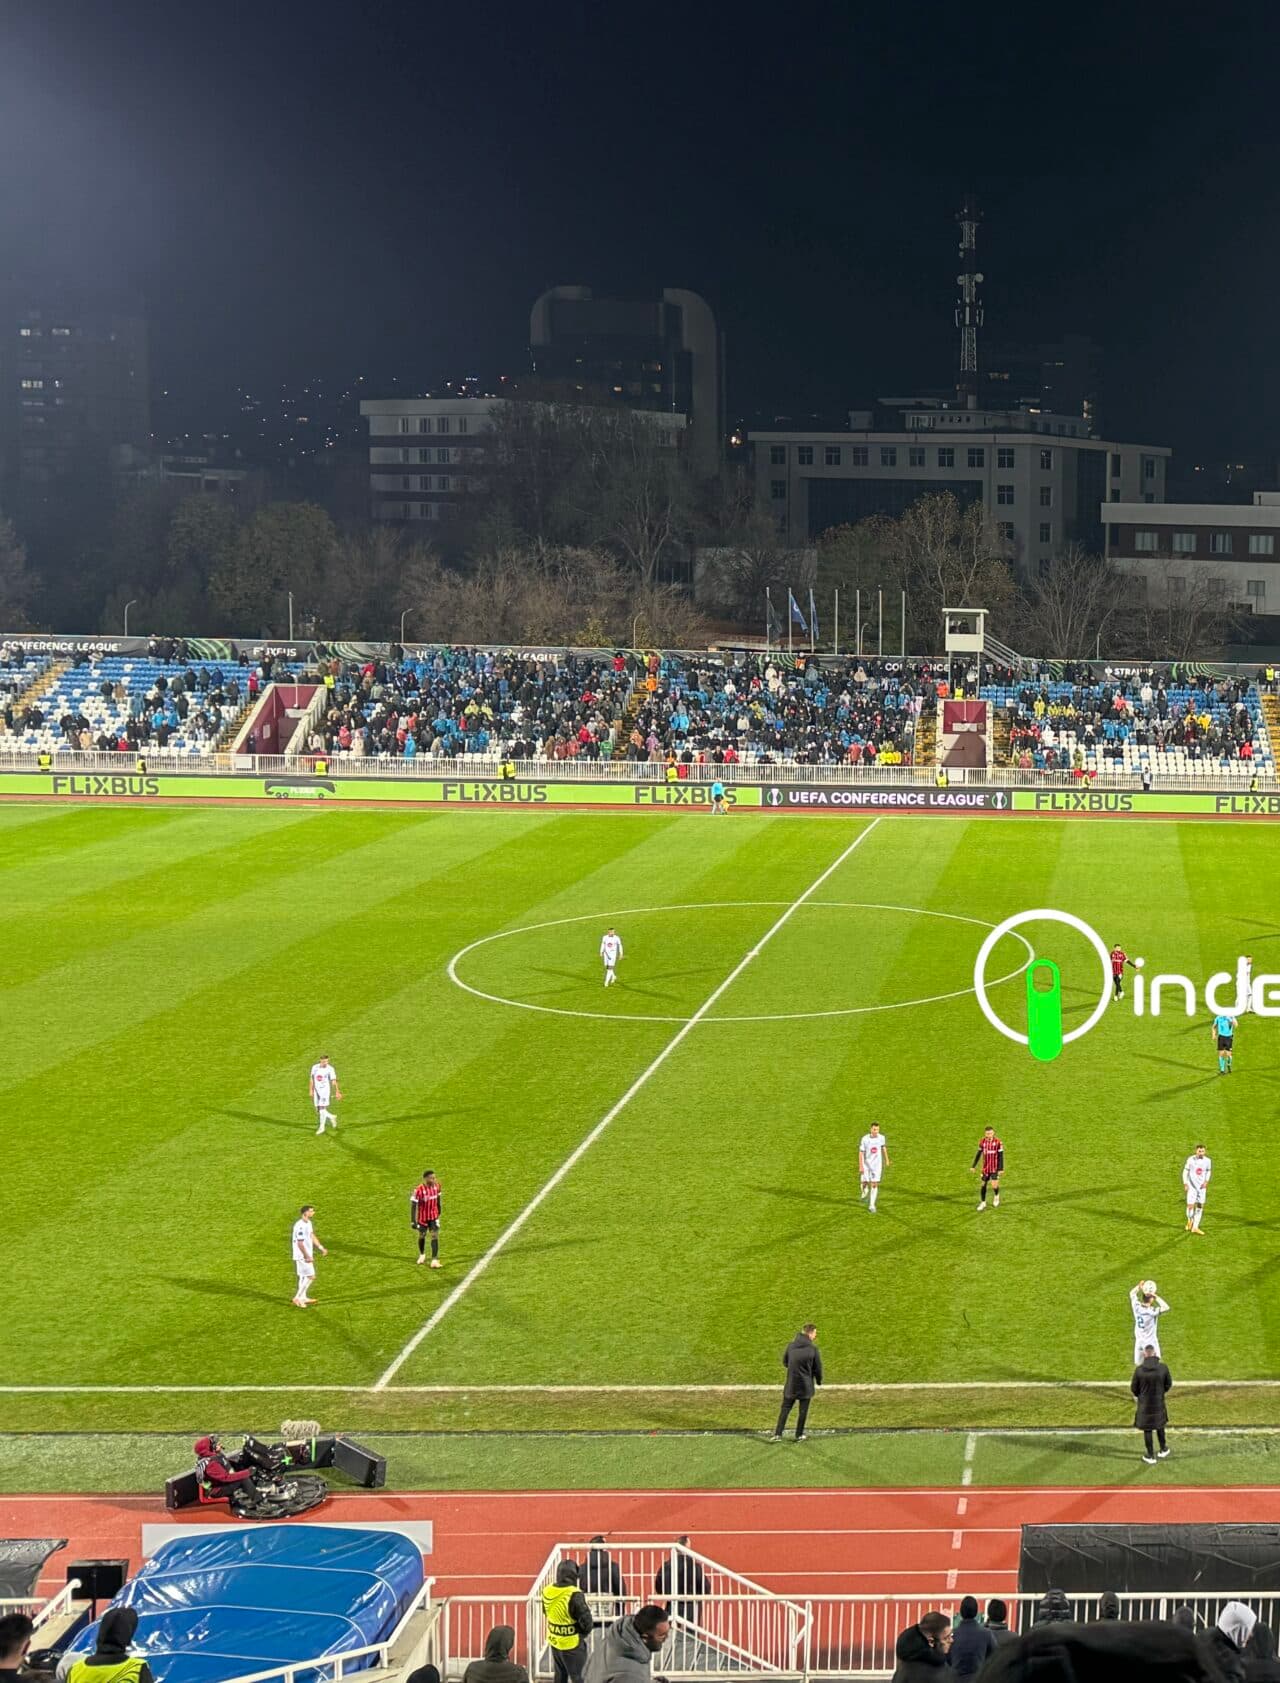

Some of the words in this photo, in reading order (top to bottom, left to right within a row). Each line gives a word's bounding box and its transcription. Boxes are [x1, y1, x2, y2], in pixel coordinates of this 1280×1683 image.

[77, 642, 118, 652] LEAGUE
[788, 791, 828, 804] UEFA
[831, 792, 925, 805] CONFERENCE
[930, 793, 985, 806] LEAGUE
